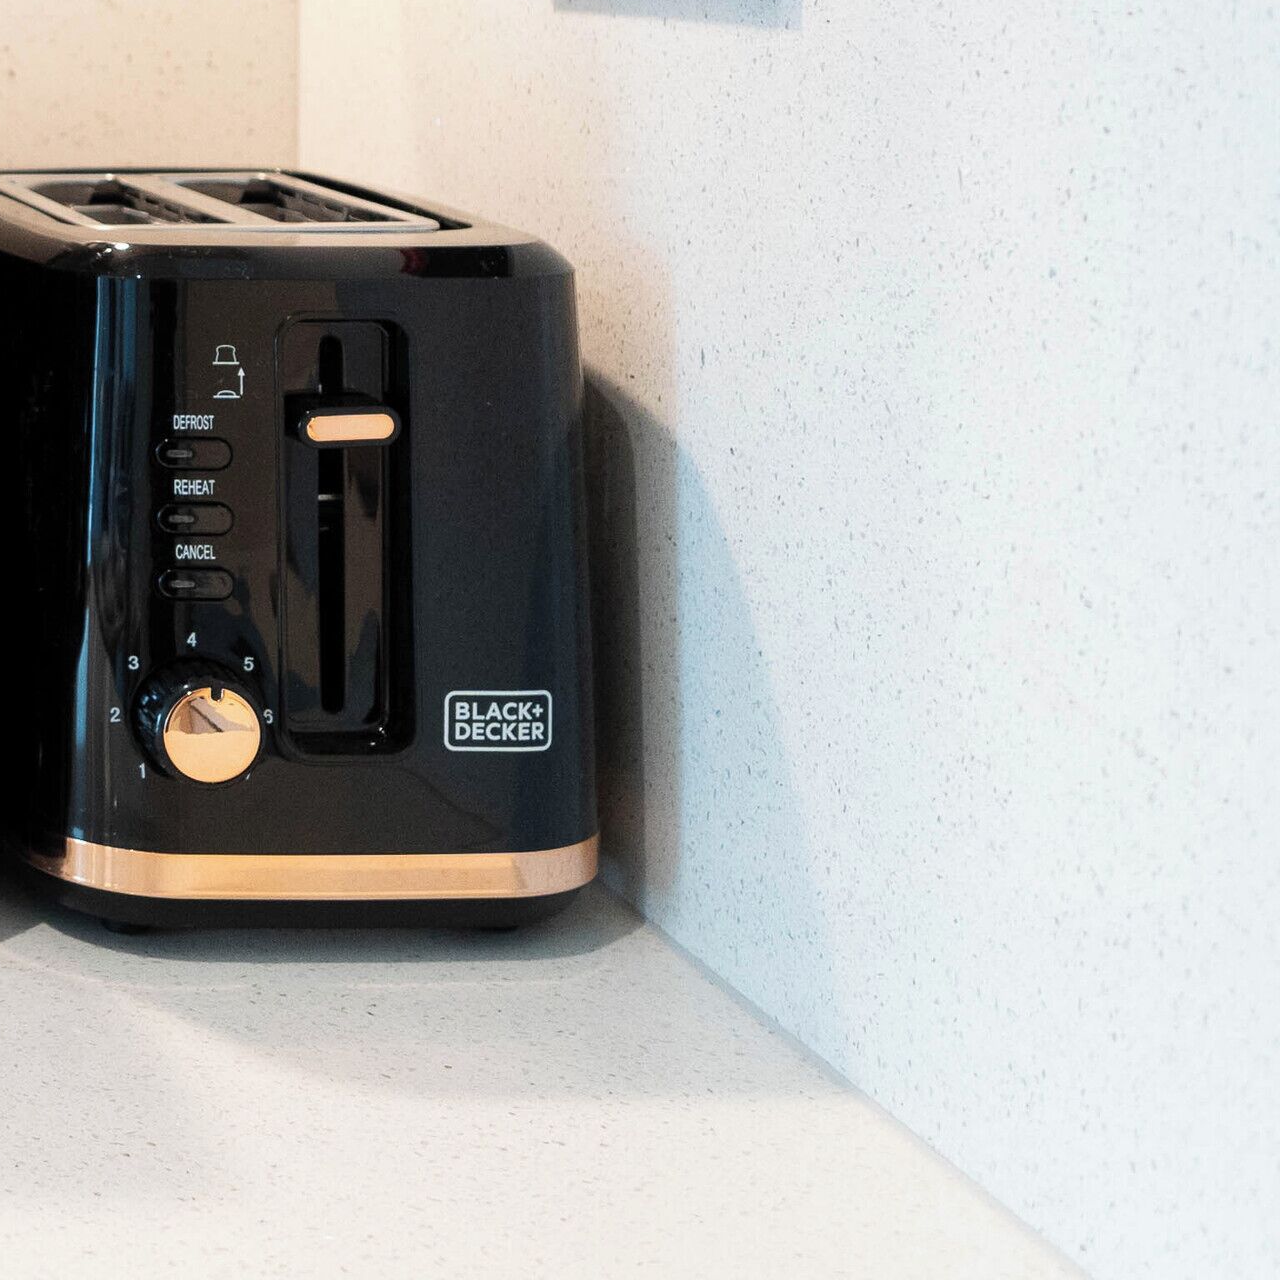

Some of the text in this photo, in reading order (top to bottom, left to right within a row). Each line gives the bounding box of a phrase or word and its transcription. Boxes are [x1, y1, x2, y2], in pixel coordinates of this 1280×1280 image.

[173, 415, 214, 431] DEFROST
[173, 479, 215, 496] REHEAT
[175, 544, 216, 561] CANCEL
[187, 633, 196, 647] 4
[128, 656, 139, 670] 3
[244, 657, 254, 671] 5
[111, 708, 121, 723] 2
[263, 709, 273, 724] 6
[455, 701, 544, 721] BLACK+
[454, 722, 545, 741] DECKER
[140, 763, 146, 779] 1
